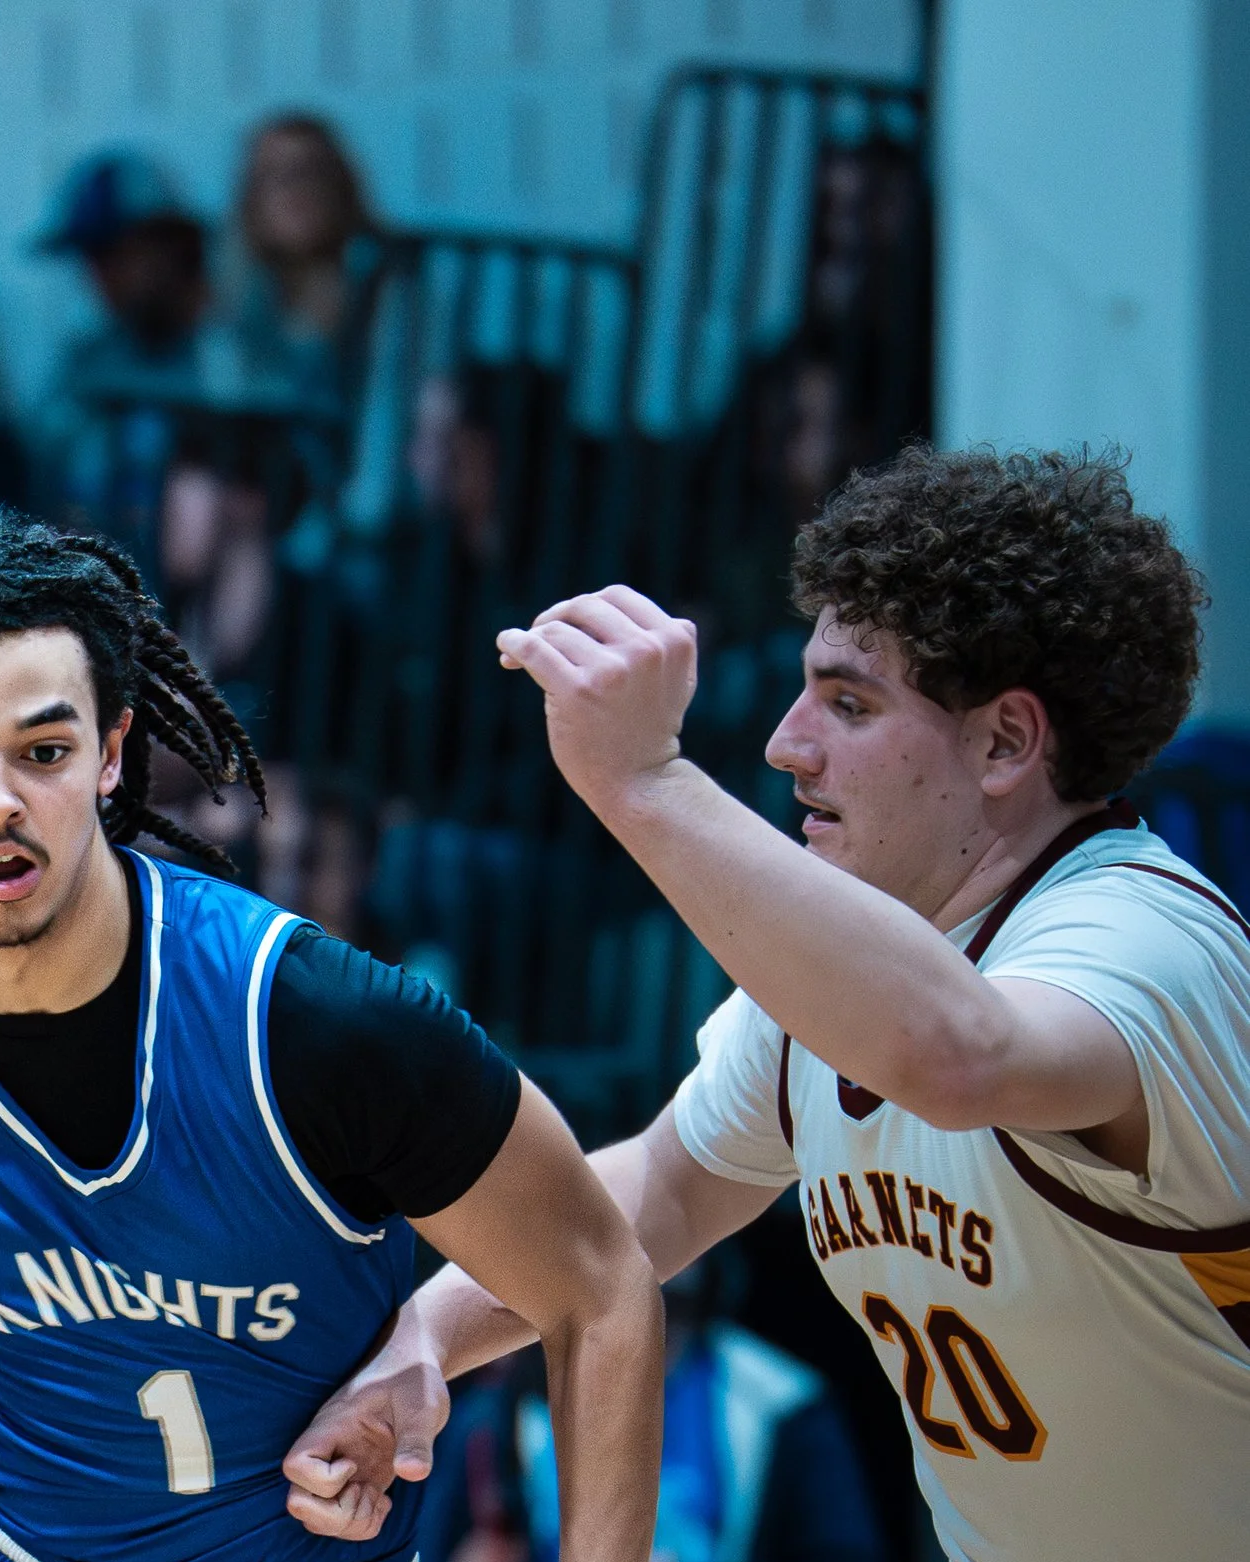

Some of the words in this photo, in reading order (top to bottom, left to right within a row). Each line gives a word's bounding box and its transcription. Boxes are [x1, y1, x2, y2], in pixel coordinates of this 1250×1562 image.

[806, 1170, 994, 1288] GARNETS
[137, 1370, 216, 1495] 1
[862, 1291, 1048, 1462] 20
